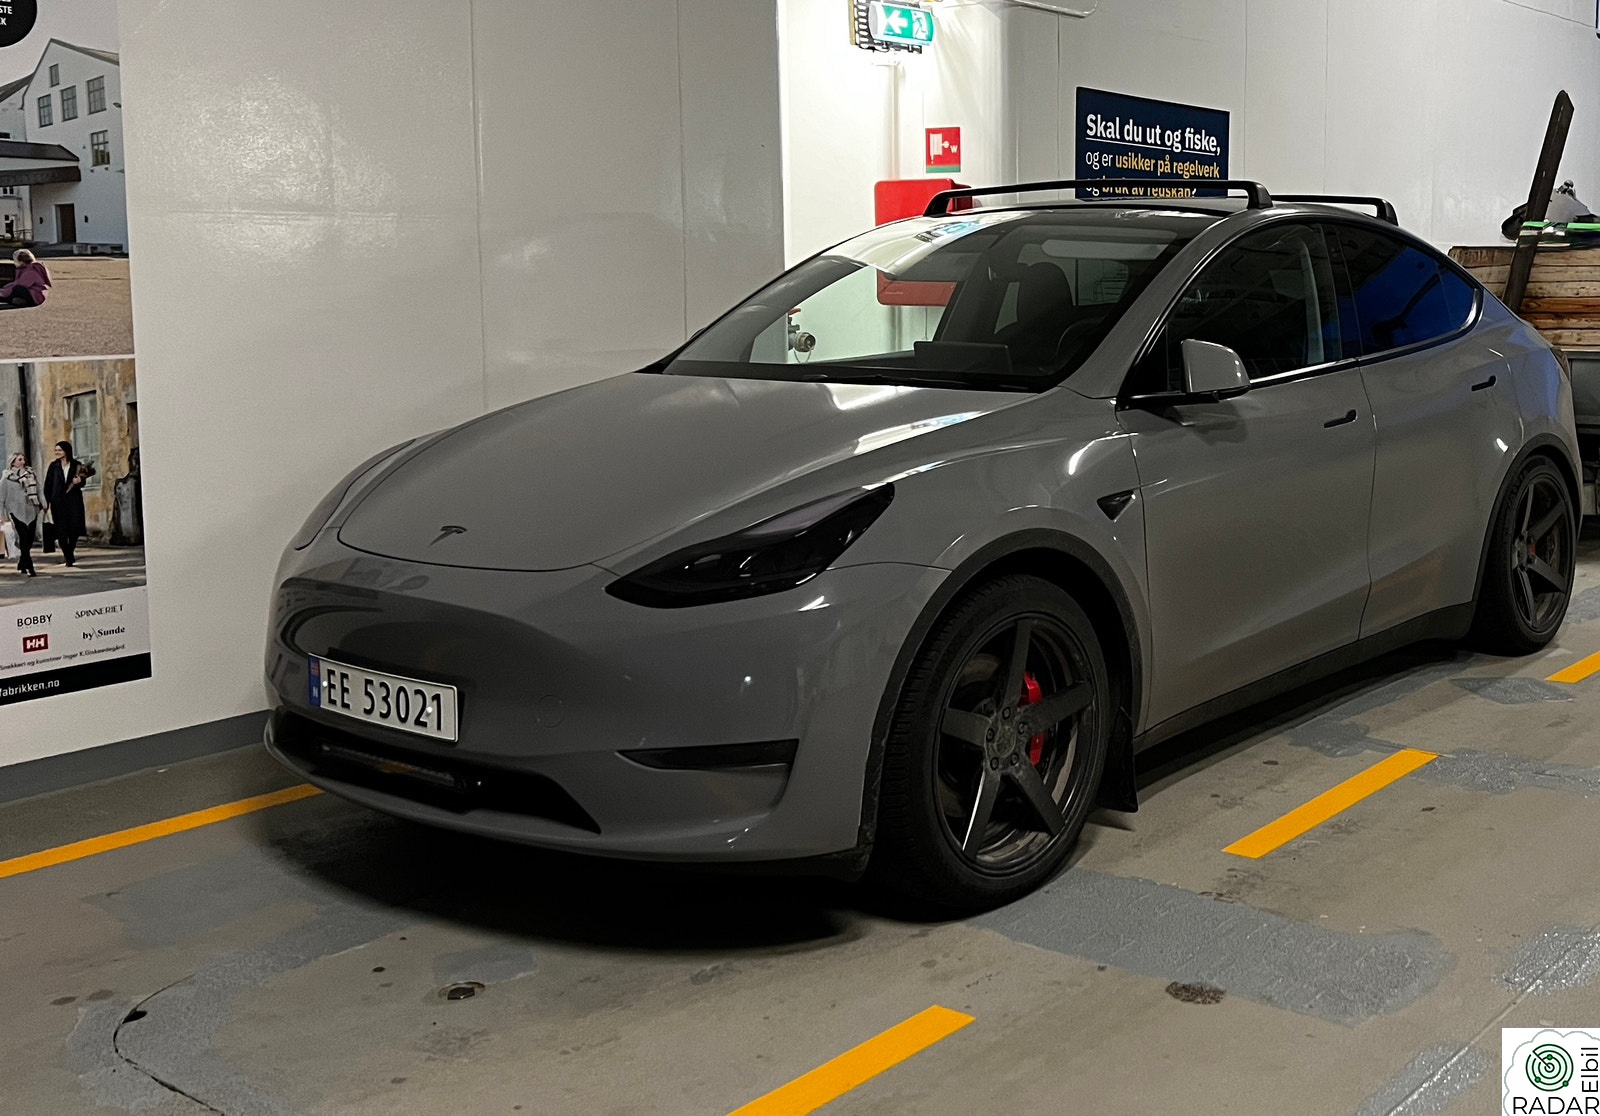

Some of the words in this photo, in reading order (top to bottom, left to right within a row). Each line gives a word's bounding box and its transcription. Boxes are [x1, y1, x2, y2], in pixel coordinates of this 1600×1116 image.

[1086, 114, 1120, 139] Skal
[1124, 119, 1142, 142] du
[1147, 125, 1161, 145] ut
[1164, 129, 1182, 152] og
[1185, 127, 1221, 155] fiske,
[1085, 152, 1100, 170] og
[1102, 153, 1113, 167] er
[1115, 152, 1155, 172] usikker
[1157, 154, 1171, 176] på
[1173, 160, 1220, 179] regelverk
[17, 613, 53, 627] BOBBY
[327, 669, 351, 710] EE
[363, 678, 442, 731] 53021
